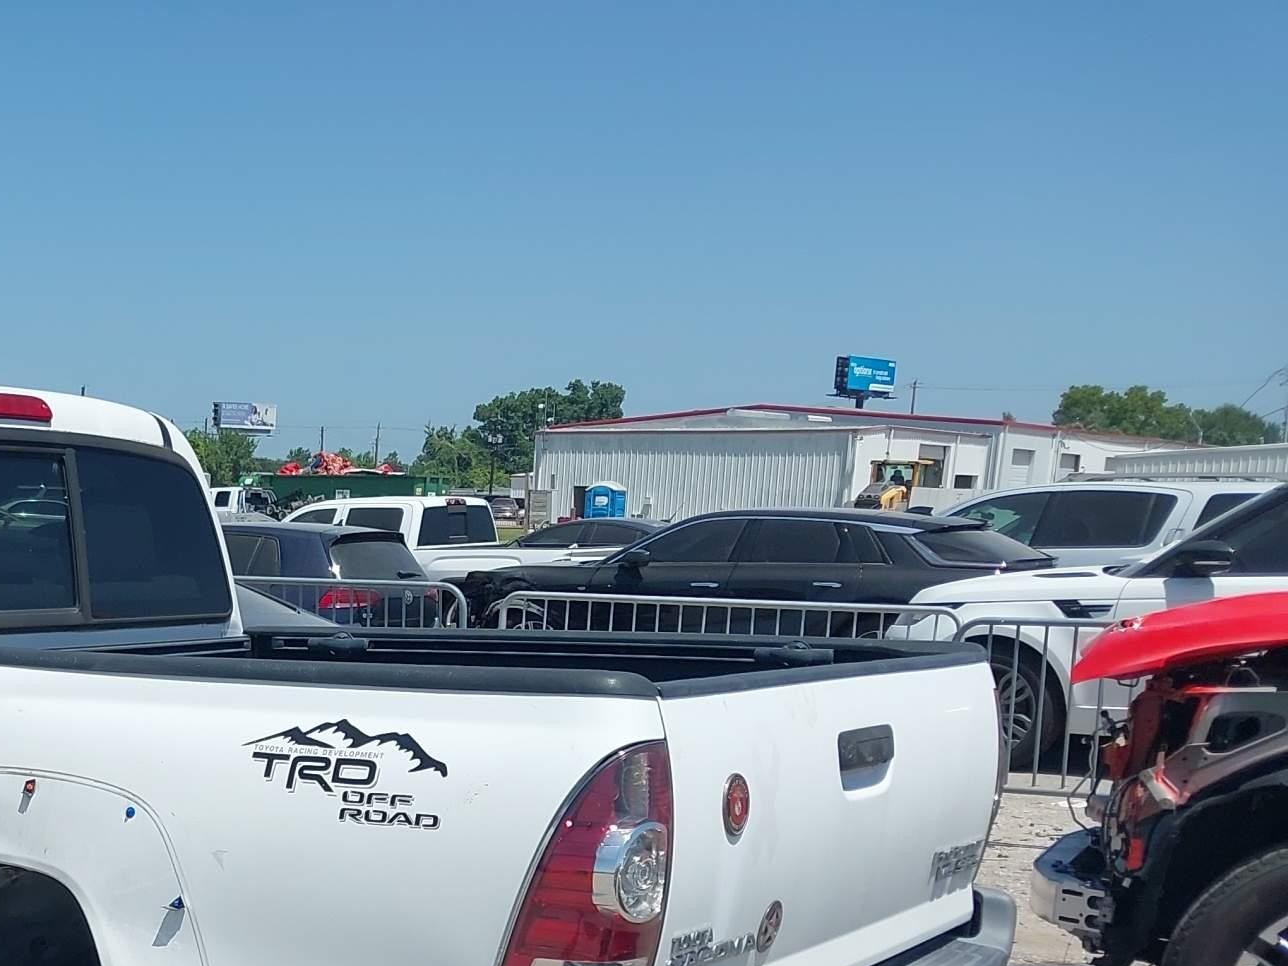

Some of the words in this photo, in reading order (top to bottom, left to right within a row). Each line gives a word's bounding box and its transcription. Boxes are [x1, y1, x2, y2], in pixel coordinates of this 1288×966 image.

[254, 743, 284, 753] TOYOTA
[288, 747, 319, 756] RACING
[322, 748, 385, 759] DEVELOPMENT
[252, 751, 379, 794] TRD
[341, 790, 414, 808] OFF
[338, 807, 440, 829] ROAD
